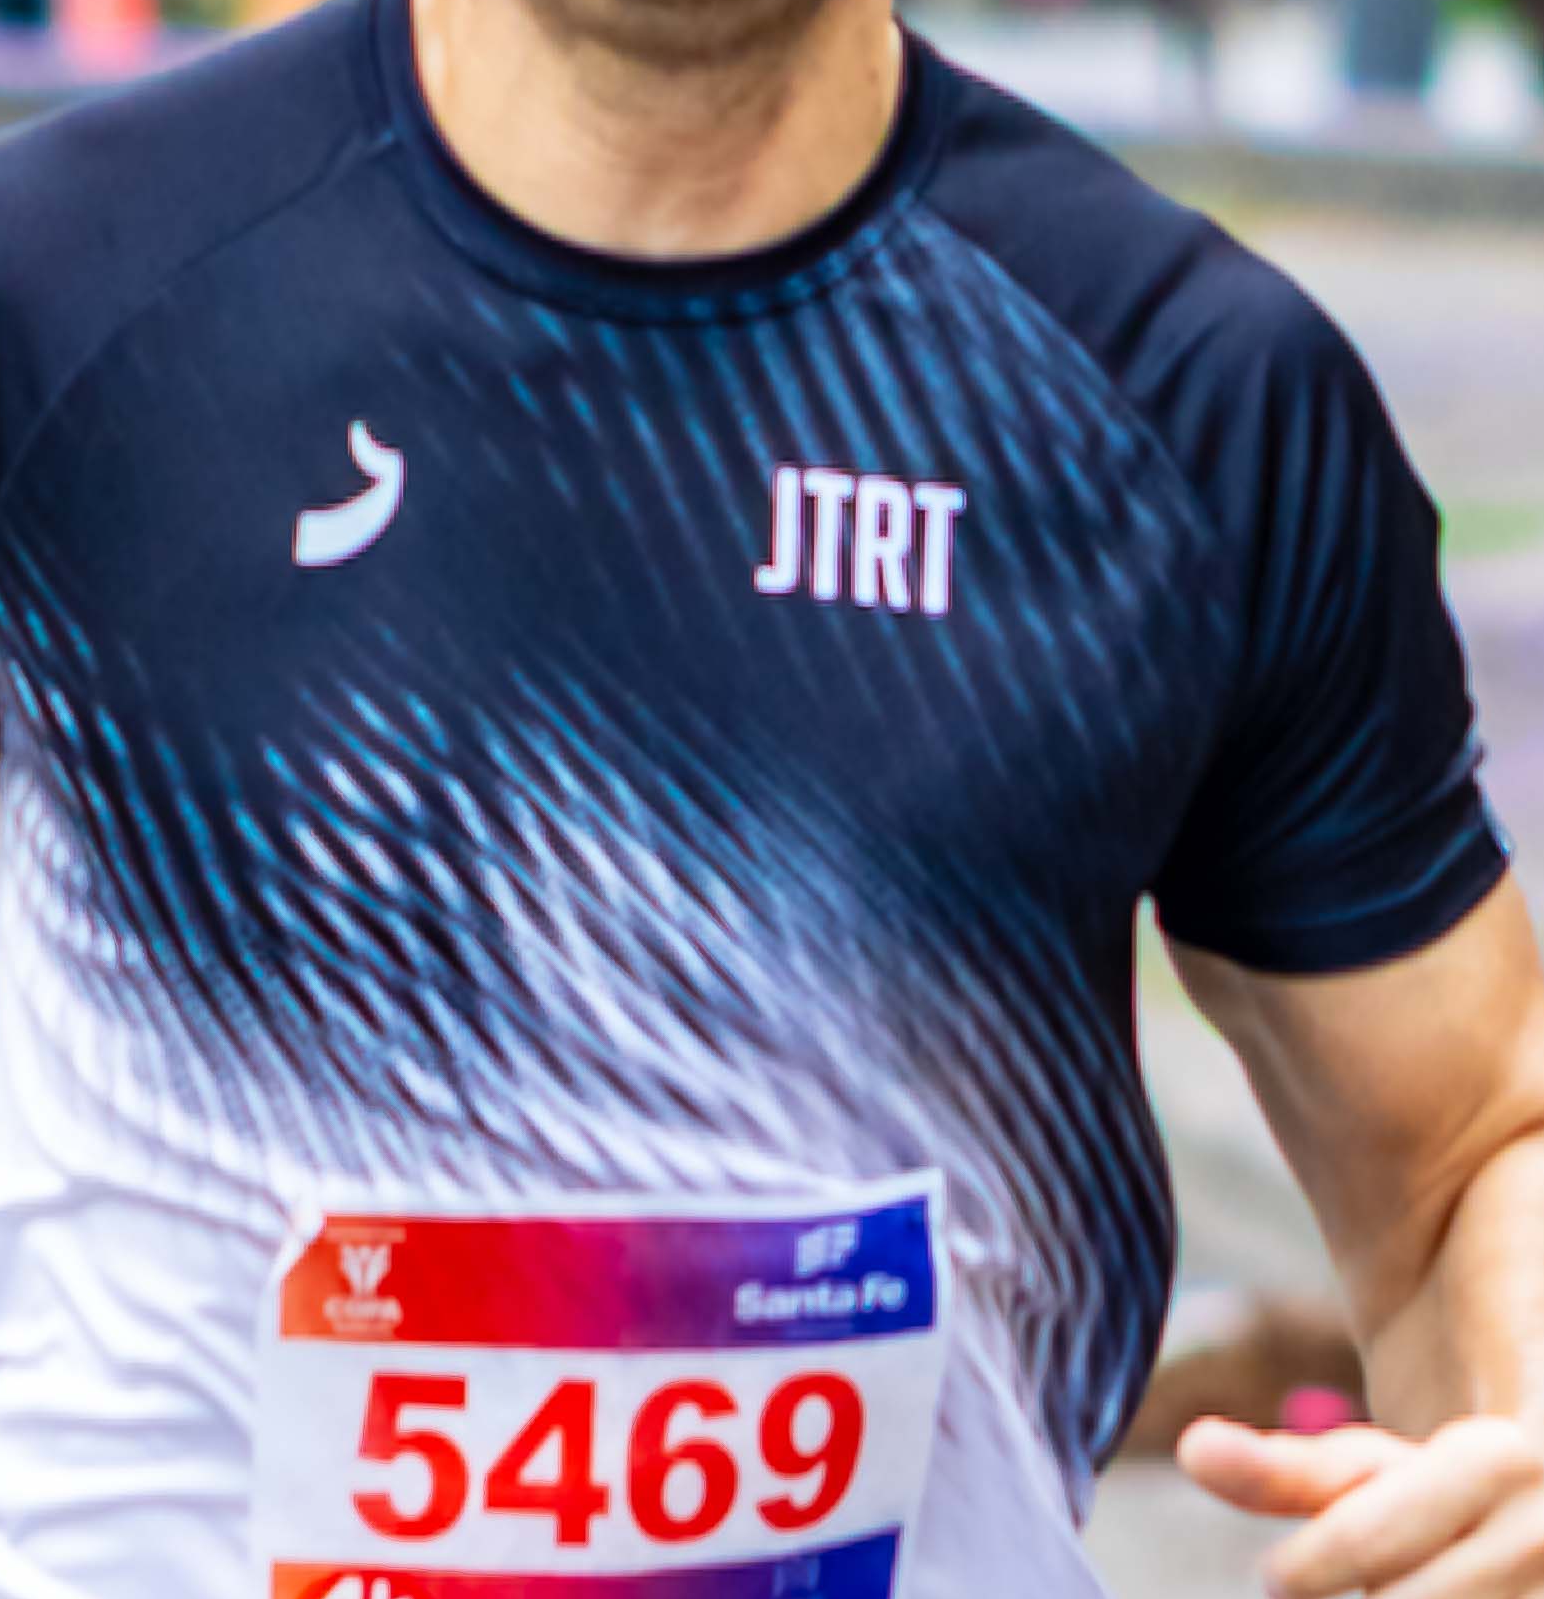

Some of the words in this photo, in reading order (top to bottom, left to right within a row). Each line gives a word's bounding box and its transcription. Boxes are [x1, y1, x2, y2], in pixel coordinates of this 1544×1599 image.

[753, 462, 967, 619] JTRT
[734, 1279, 856, 1325] Santa
[861, 1271, 908, 1315] Fe
[350, 1369, 865, 1546] 5469
